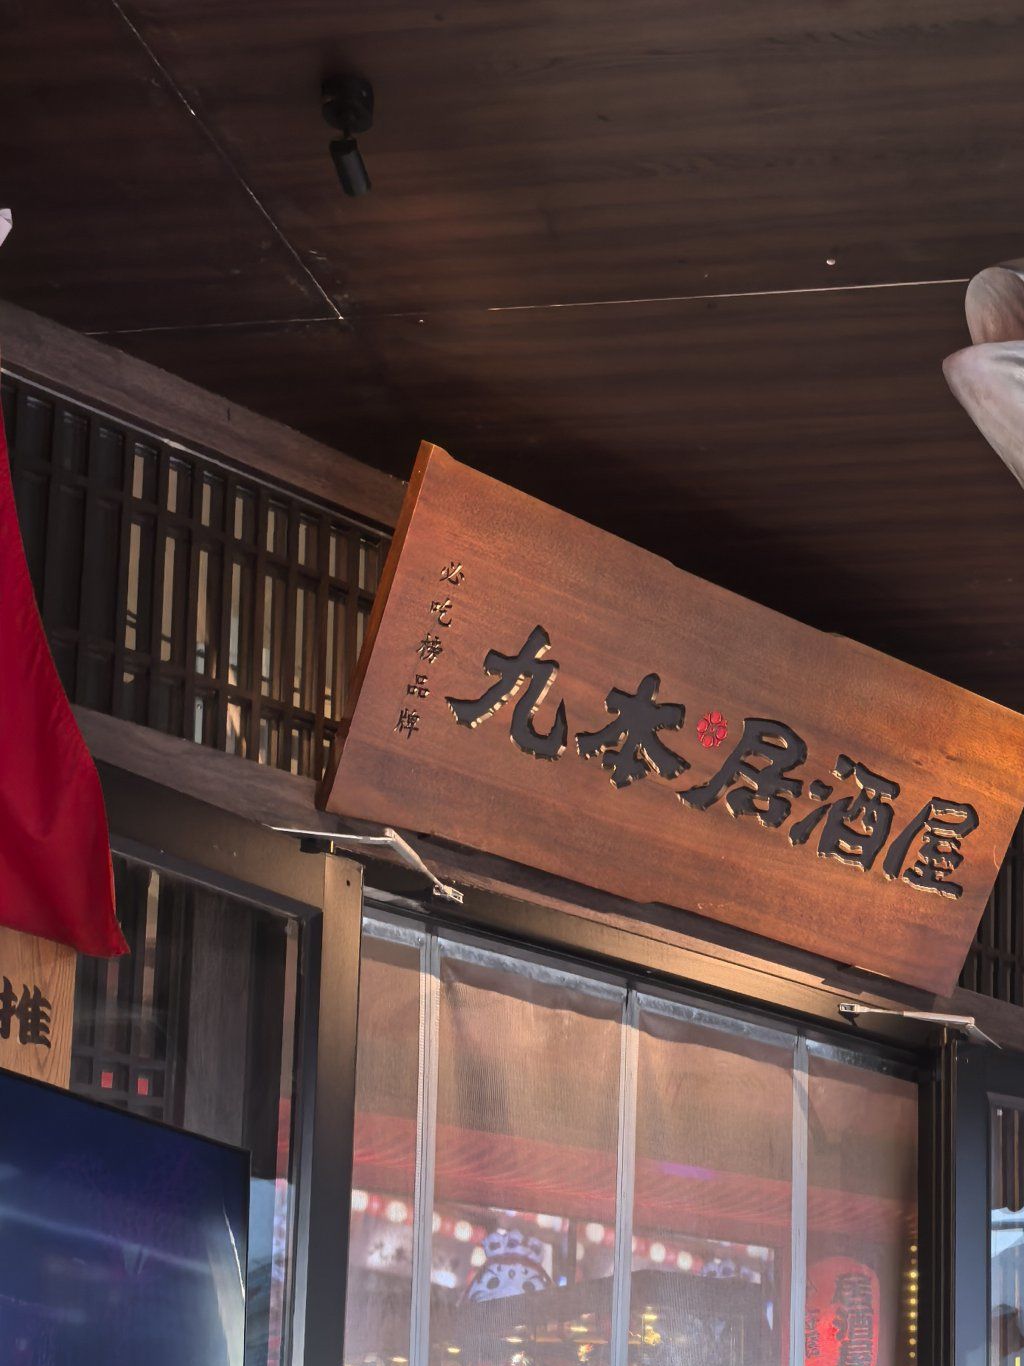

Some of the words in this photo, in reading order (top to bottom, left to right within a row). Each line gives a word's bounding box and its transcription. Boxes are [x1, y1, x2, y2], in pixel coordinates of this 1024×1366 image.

[393, 561, 466, 740] 必吃榜品牌
[445, 624, 979, 900] 九本居酒屋
[0, 975, 52, 1049] 推
